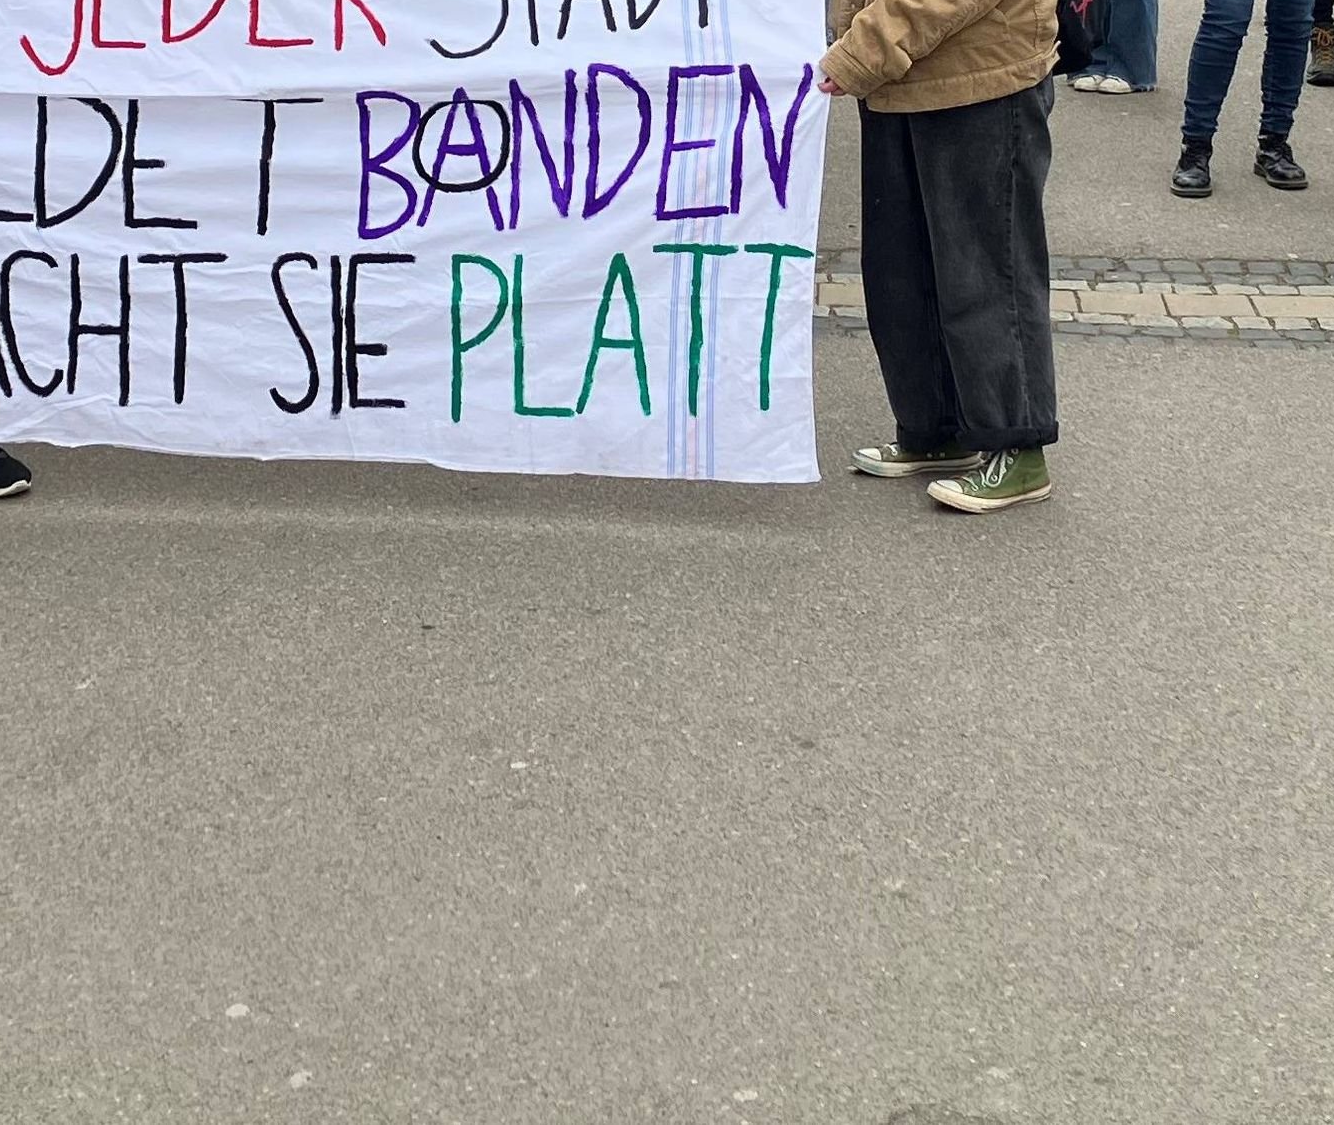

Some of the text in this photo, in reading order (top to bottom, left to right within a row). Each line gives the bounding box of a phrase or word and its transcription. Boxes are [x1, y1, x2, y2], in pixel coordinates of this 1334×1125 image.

[356, 62, 814, 240] BANDEN
[269, 251, 416, 420] SIE
[451, 243, 815, 423] PLATT
